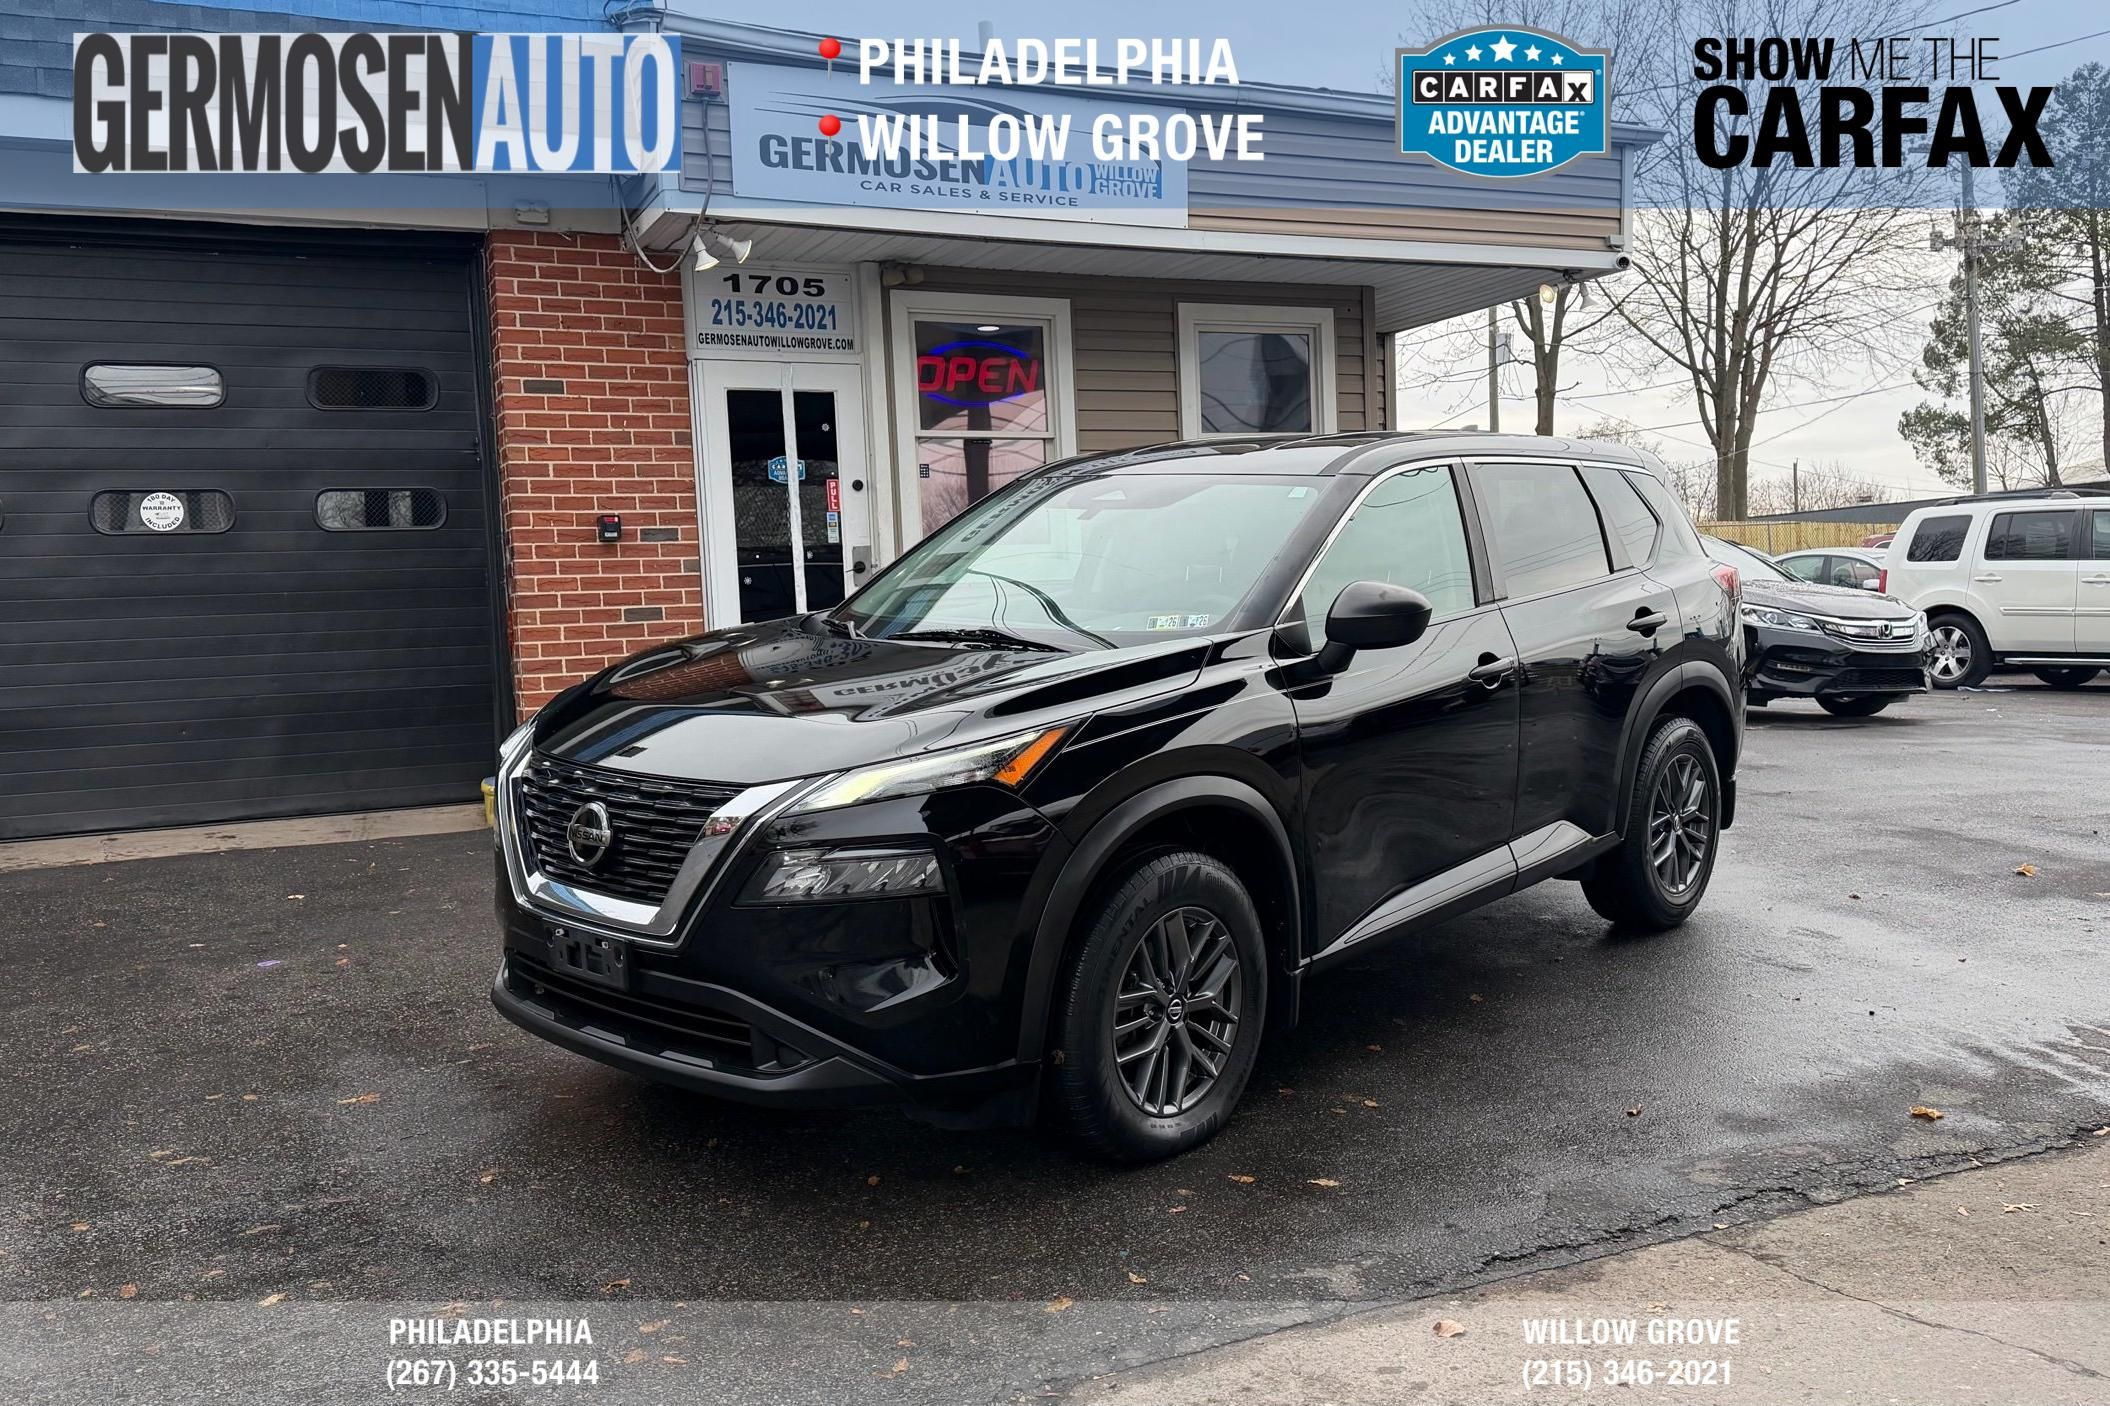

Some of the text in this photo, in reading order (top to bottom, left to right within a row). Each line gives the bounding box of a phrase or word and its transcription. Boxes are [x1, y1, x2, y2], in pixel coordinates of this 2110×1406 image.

[1094, 163, 1159, 183] WILLOW
[860, 180, 1079, 207] CAR SALES & SERVICE
[1094, 179, 1158, 199] GROVE
[722, 273, 826, 298] 1705
[711, 298, 837, 331] 215-346-2021
[698, 332, 854, 351] GERMOSENAUTOWILLOWGROVE.COM
[916, 355, 1039, 393] OPEN
[161, 494, 176, 503] DAY
[829, 481, 839, 510] PULL
[145, 516, 181, 529] INCLUDED
